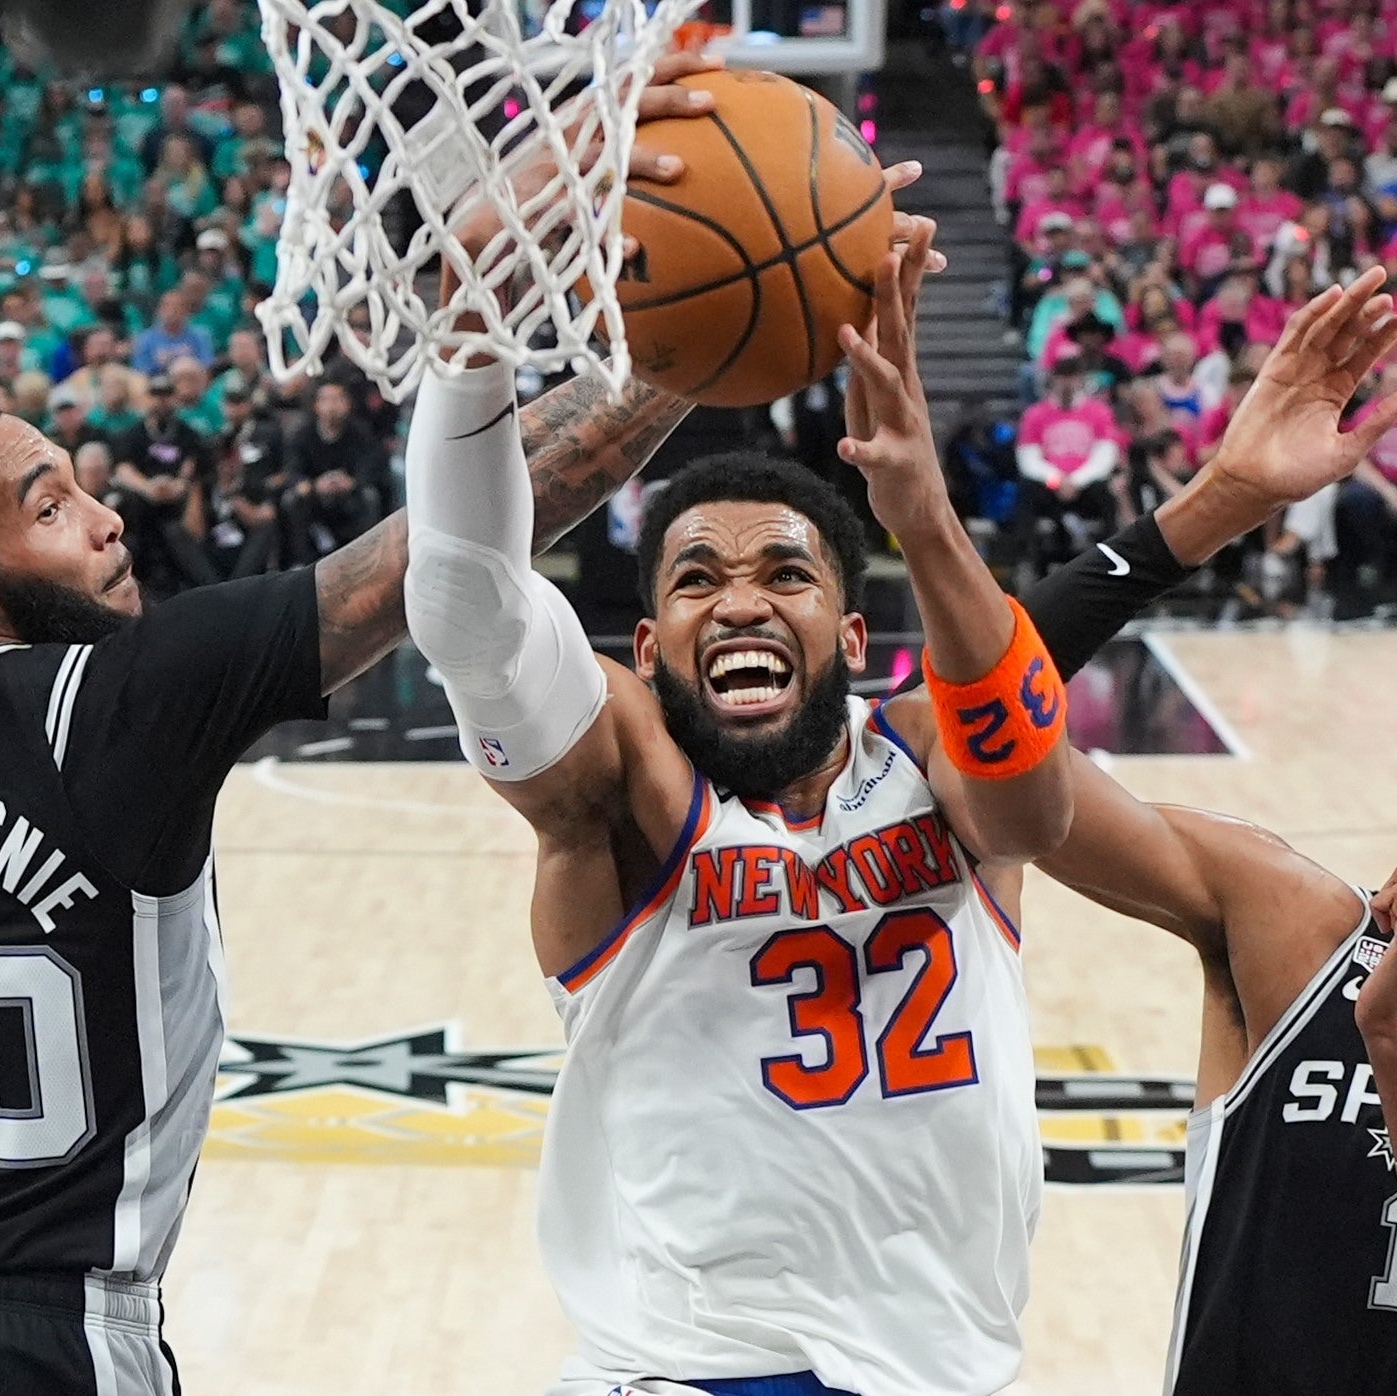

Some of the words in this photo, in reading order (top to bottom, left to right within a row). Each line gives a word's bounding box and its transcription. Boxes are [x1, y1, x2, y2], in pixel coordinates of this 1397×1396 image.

[956, 656, 1060, 764] 32
[687, 844, 819, 931] NEW
[816, 814, 963, 914] YORK
[749, 906, 979, 1110] 32
